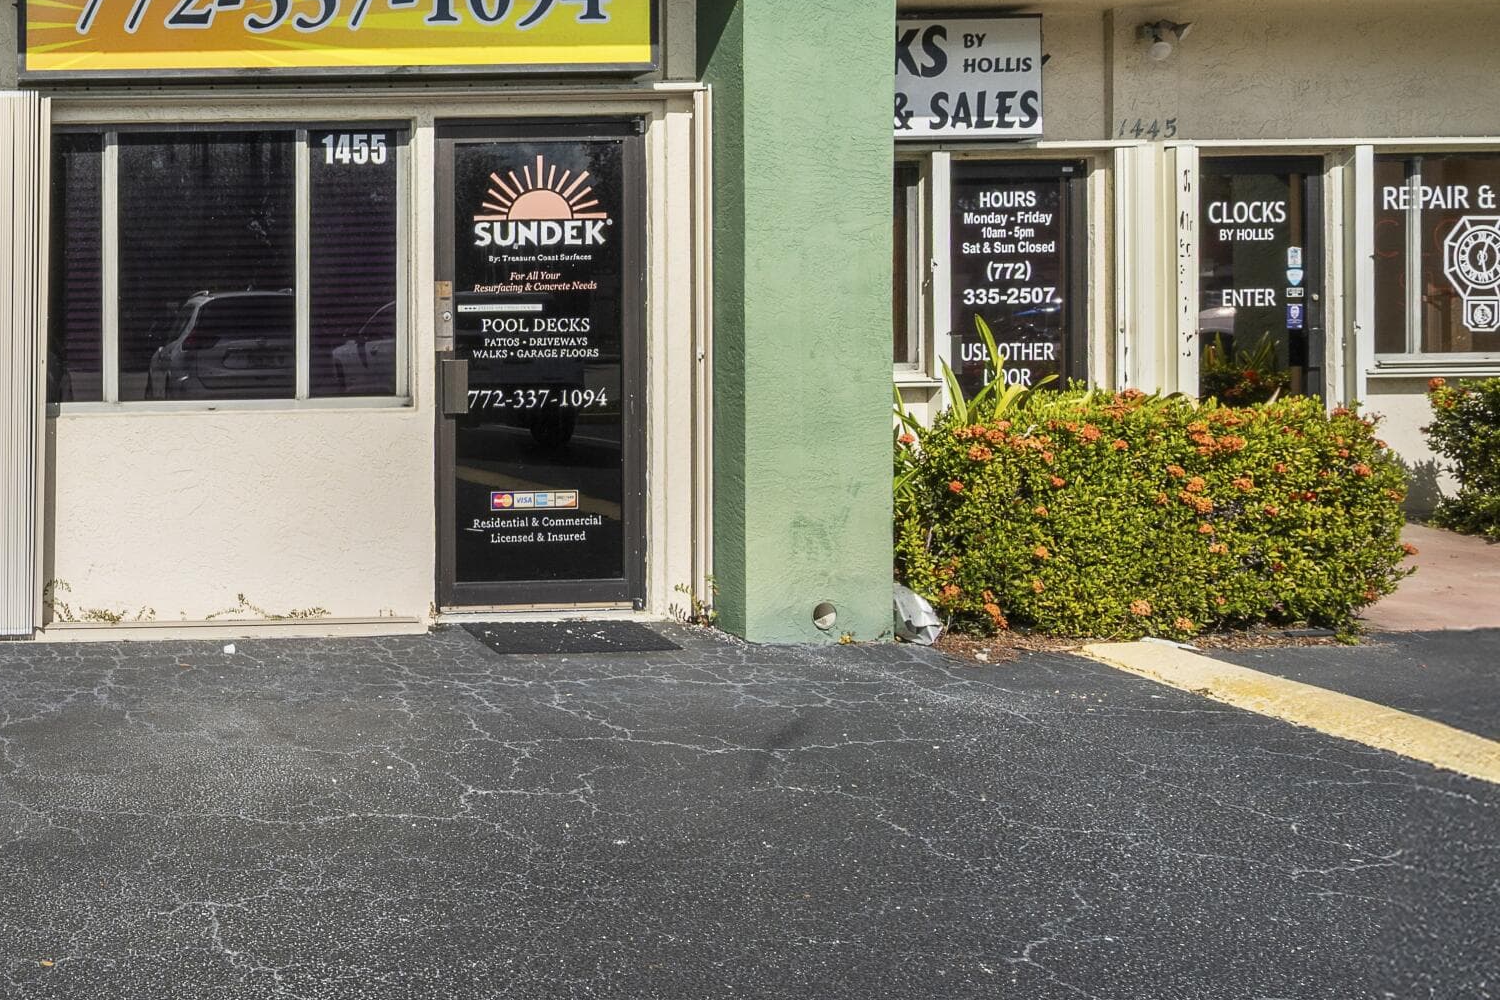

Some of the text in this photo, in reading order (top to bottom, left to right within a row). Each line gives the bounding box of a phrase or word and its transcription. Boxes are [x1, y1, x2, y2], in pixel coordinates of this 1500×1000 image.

[963, 33, 986, 48] BY
[963, 57, 1032, 73] HOLLIS
[929, 90, 1038, 130] SALES
[1119, 118, 1177, 138] 1445
[321, 134, 387, 165] 1455
[979, 191, 1036, 208] HOURS
[1382, 185, 1496, 210] REPAIR &
[964, 212, 1007, 226] Monday
[1017, 211, 1052, 226] Friday
[1208, 201, 1286, 224] CLOCKS
[474, 220, 606, 247] SUNDEK
[981, 227, 1006, 238] 10am
[1014, 226, 1034, 240] 5pm
[1219, 228, 1274, 241] BY HOLLIS
[962, 241, 1055, 253] Sat & Sun Closed
[488, 255, 501, 263] By:
[502, 254, 536, 262] Treasure
[560, 253, 592, 261] Surfaces
[510, 270, 560, 281] For All Your
[986, 260, 1031, 281] (772)
[474, 281, 597, 294] Resurfacing & Concrete Needs
[963, 287, 1056, 304] 335-2507
[1222, 288, 1276, 307] ENTER
[481, 317, 590, 333] POOL DECKS
[484, 337, 588, 347] PATIOS DRIVEWAYS
[472, 348, 599, 358] WALKS GARAGE FLOORS
[998, 342, 1055, 360] OTHER
[468, 387, 607, 409] 772-337-1094
[516, 496, 532, 504] VISA
[473, 515, 602, 529] Residential & Commercial
[490, 530, 586, 543] Licensed & Insured
